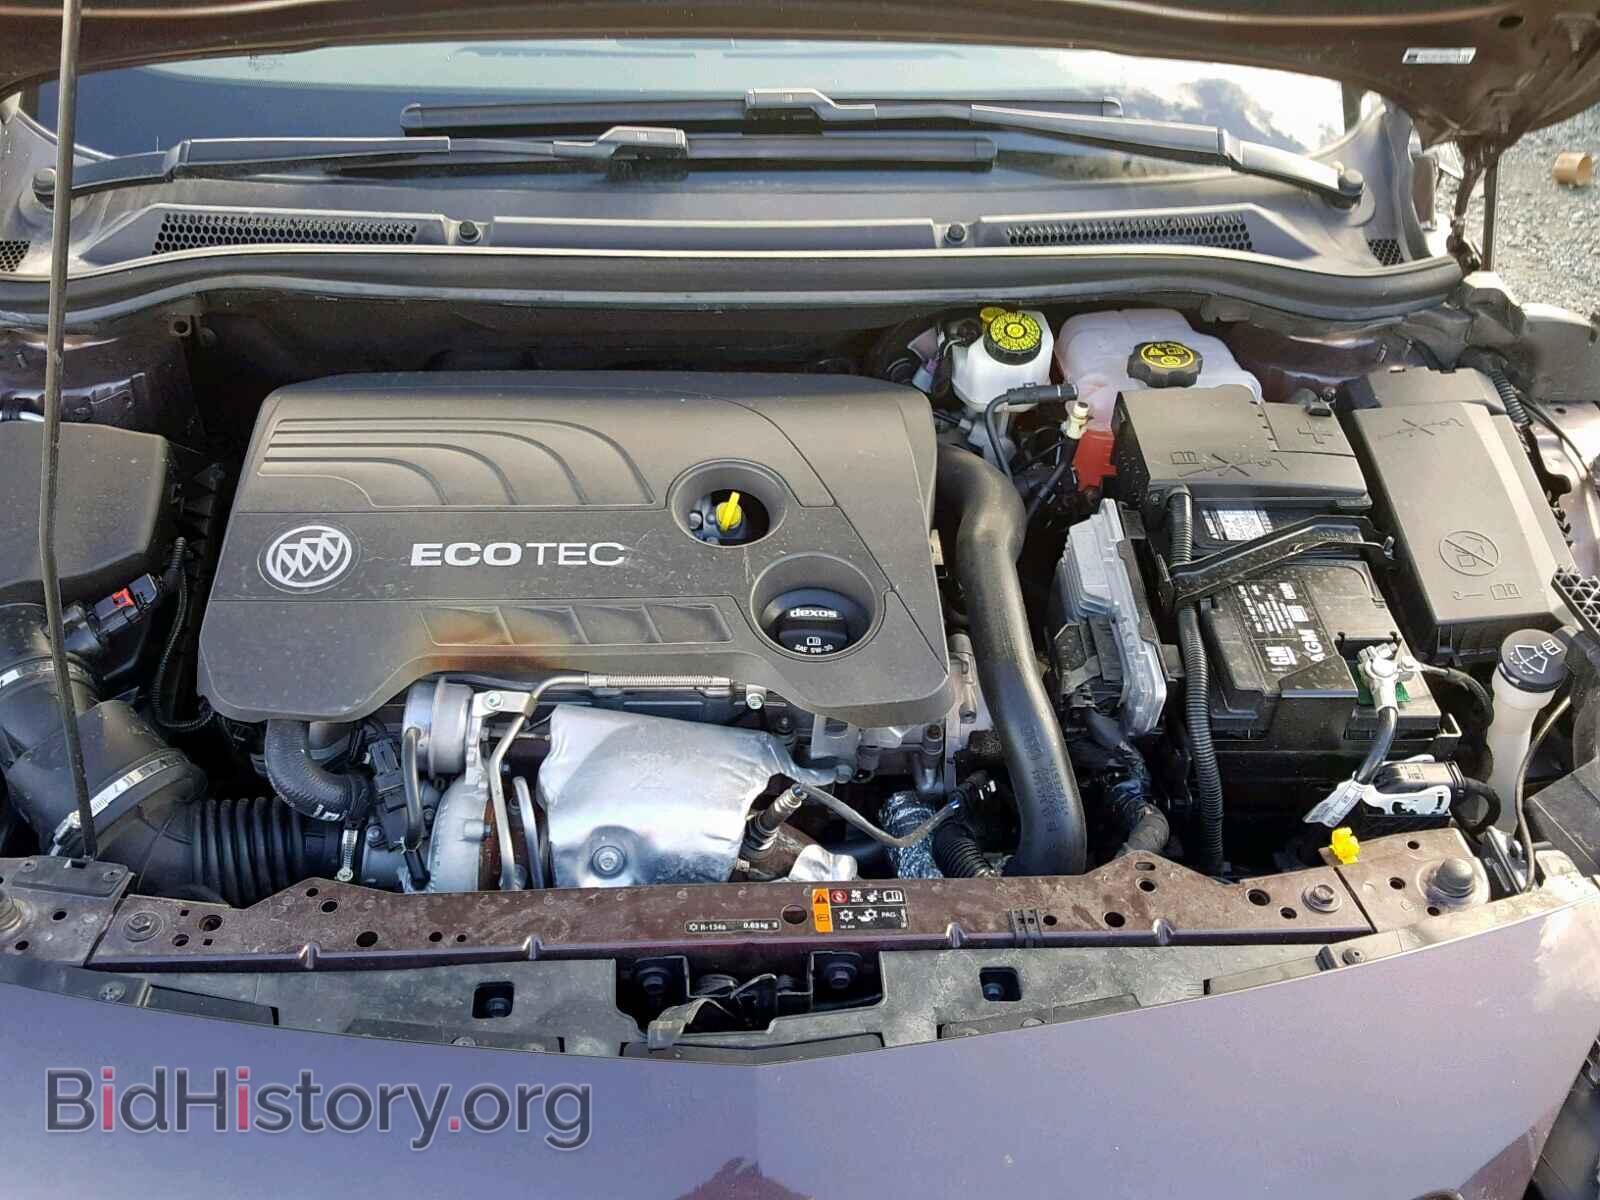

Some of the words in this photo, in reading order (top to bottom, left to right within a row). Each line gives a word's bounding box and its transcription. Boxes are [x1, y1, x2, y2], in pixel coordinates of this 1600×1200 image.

[410, 542, 625, 566] ECOTEC
[790, 608, 837, 618] dexos
[1298, 629, 1326, 662] AGM
[1264, 646, 1293, 666] GM
[700, 923, 726, 931] R-134a
